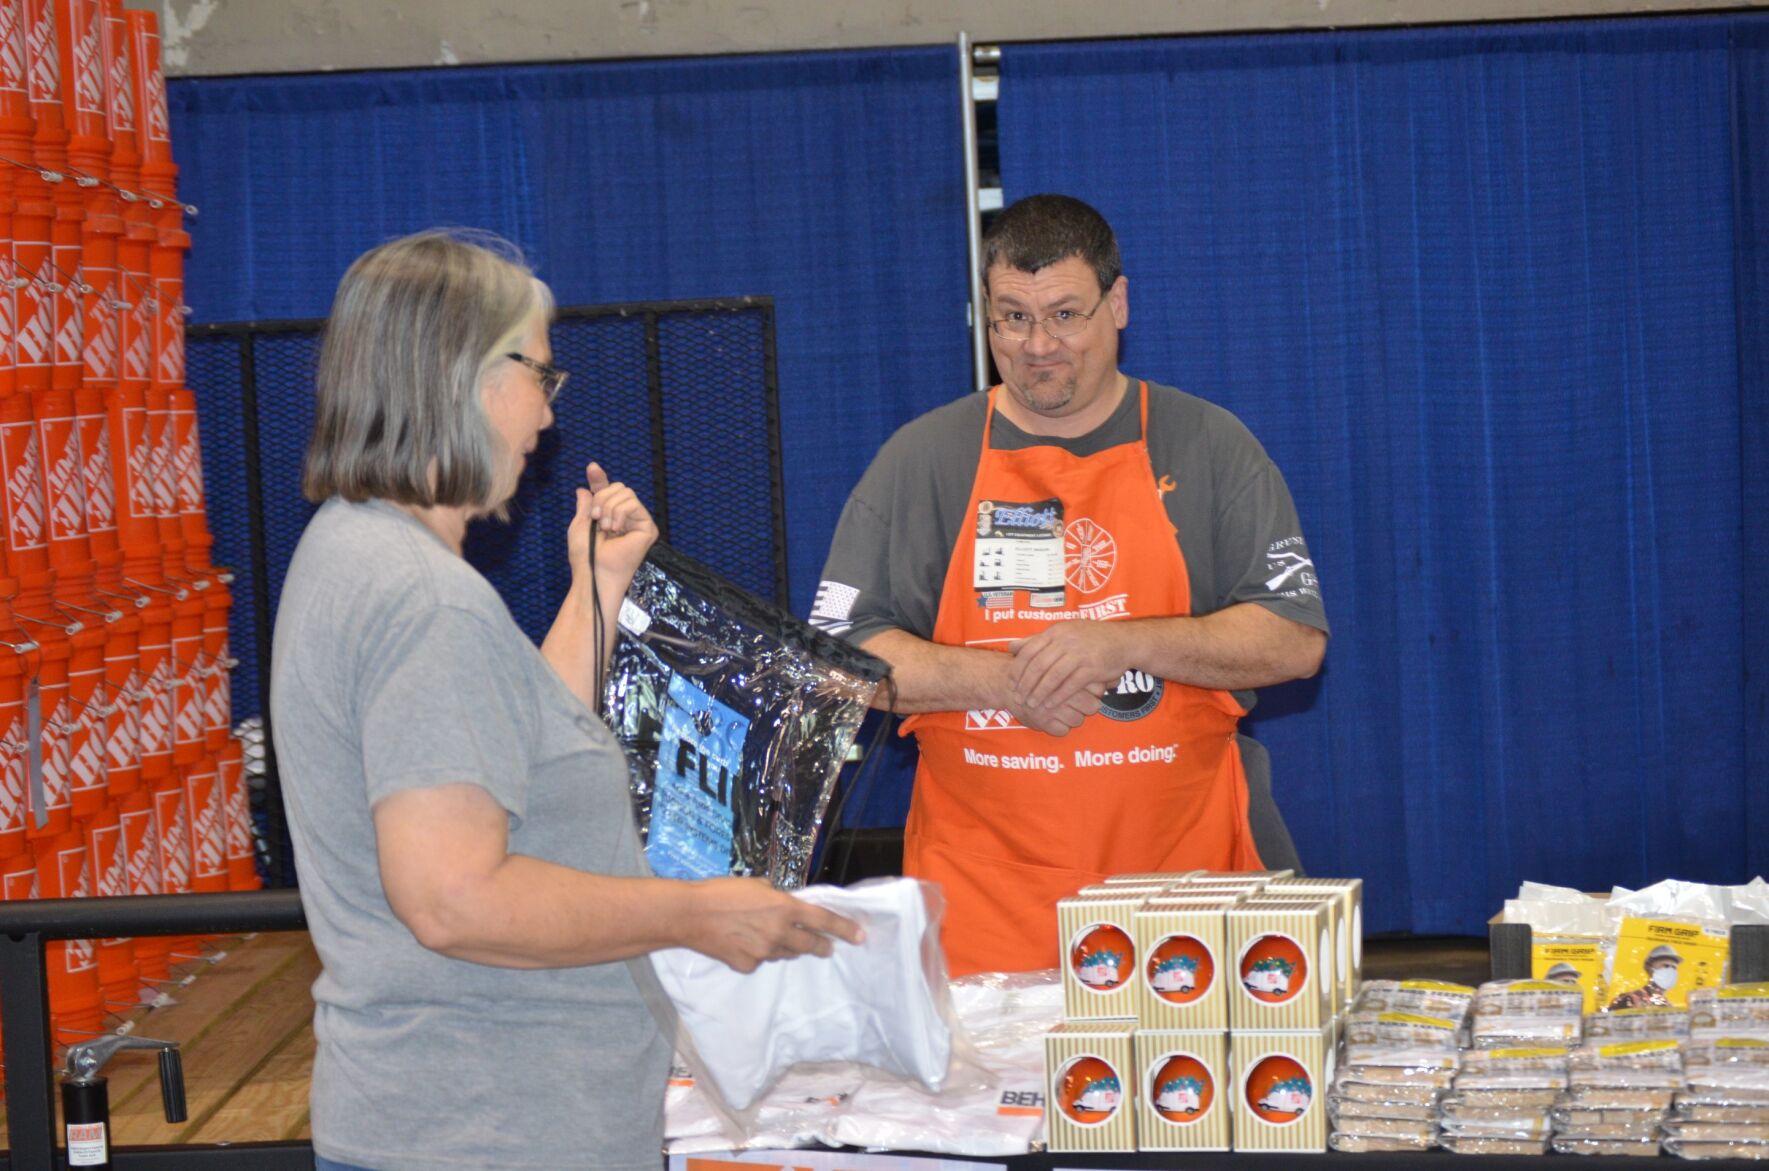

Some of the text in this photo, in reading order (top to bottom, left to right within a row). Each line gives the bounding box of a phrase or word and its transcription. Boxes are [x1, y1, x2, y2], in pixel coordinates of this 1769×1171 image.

[984, 609, 990, 620] I
[993, 609, 1014, 623] put
[1080, 598, 1128, 620] FIRST
[1104, 670, 1154, 695] RO
[964, 747, 998, 766] More
[1001, 753, 1065, 774] saving.
[1074, 750, 1124, 768] More
[1000, 1091, 1045, 1106] BEH
